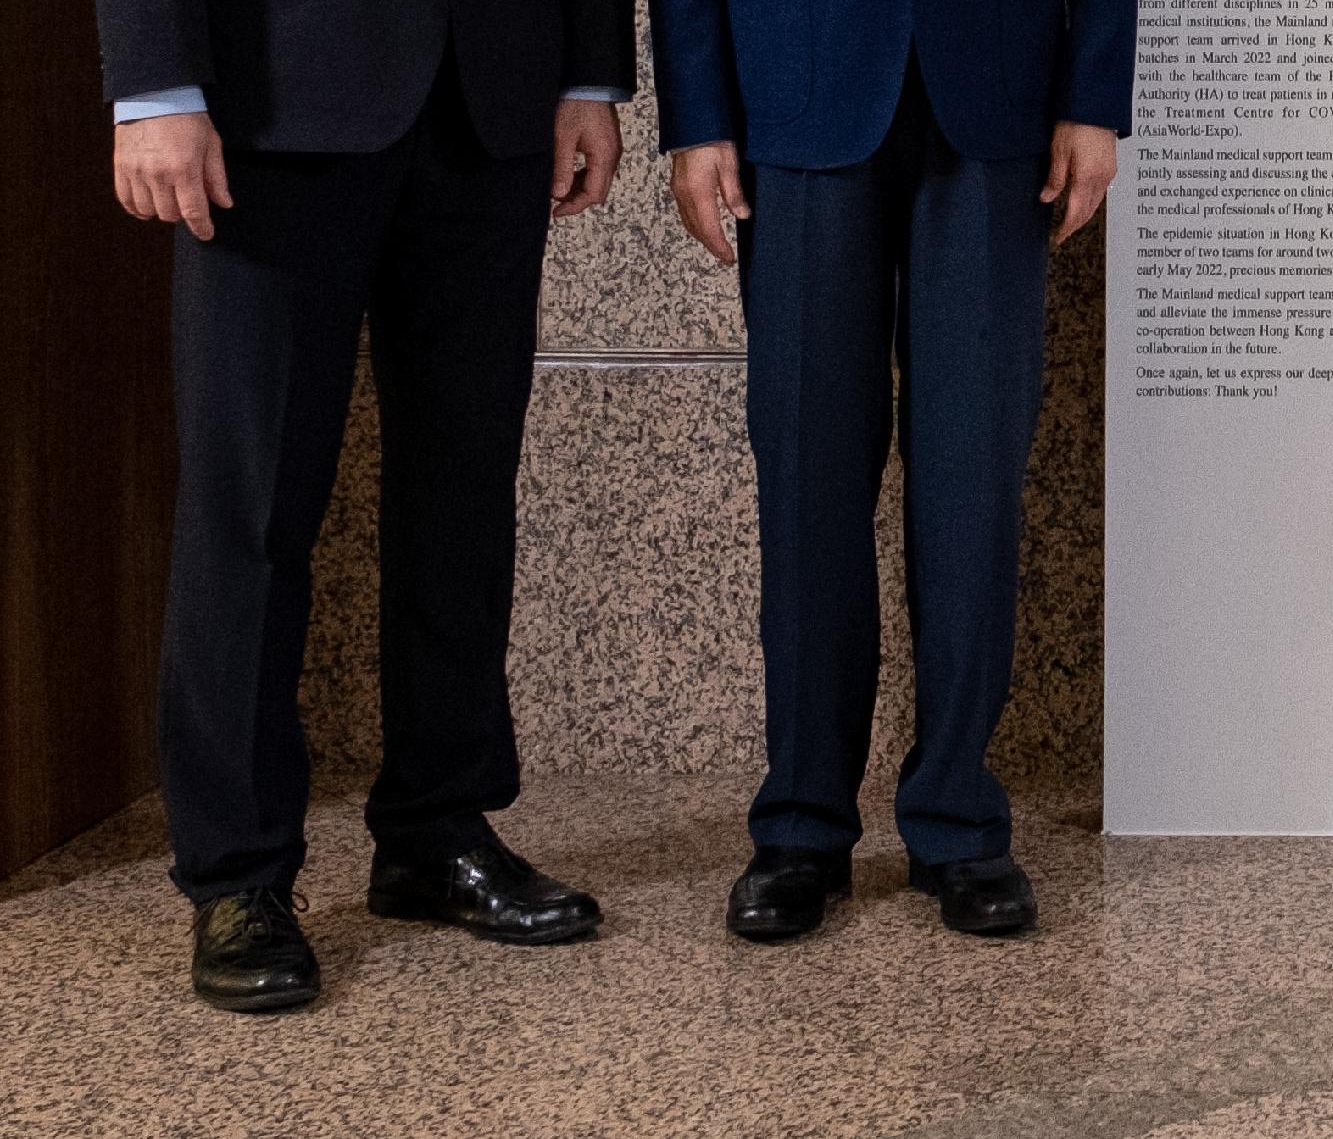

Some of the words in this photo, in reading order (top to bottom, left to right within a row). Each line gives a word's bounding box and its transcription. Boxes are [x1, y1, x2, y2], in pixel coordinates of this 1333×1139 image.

[1137, 106, 1155, 118] the
[1166, 106, 1225, 118] Treatment
[1234, 106, 1273, 118] Centre
[1282, 106, 1299, 118] for
[1138, 148, 1159, 160] The
[1162, 148, 1214, 160] Mainland
[1216, 148, 1260, 160] medical
[1263, 148, 1303, 163] support
[1306, 148, 1333, 160] team
[1136, 342, 1207, 354] collaboration
[1211, 342, 1222, 354] in
[1225, 342, 1242, 354] the
[1245, 342, 1278, 354] future.
[1215, 384, 1249, 396] Thank
[1253, 384, 1277, 399] you!
